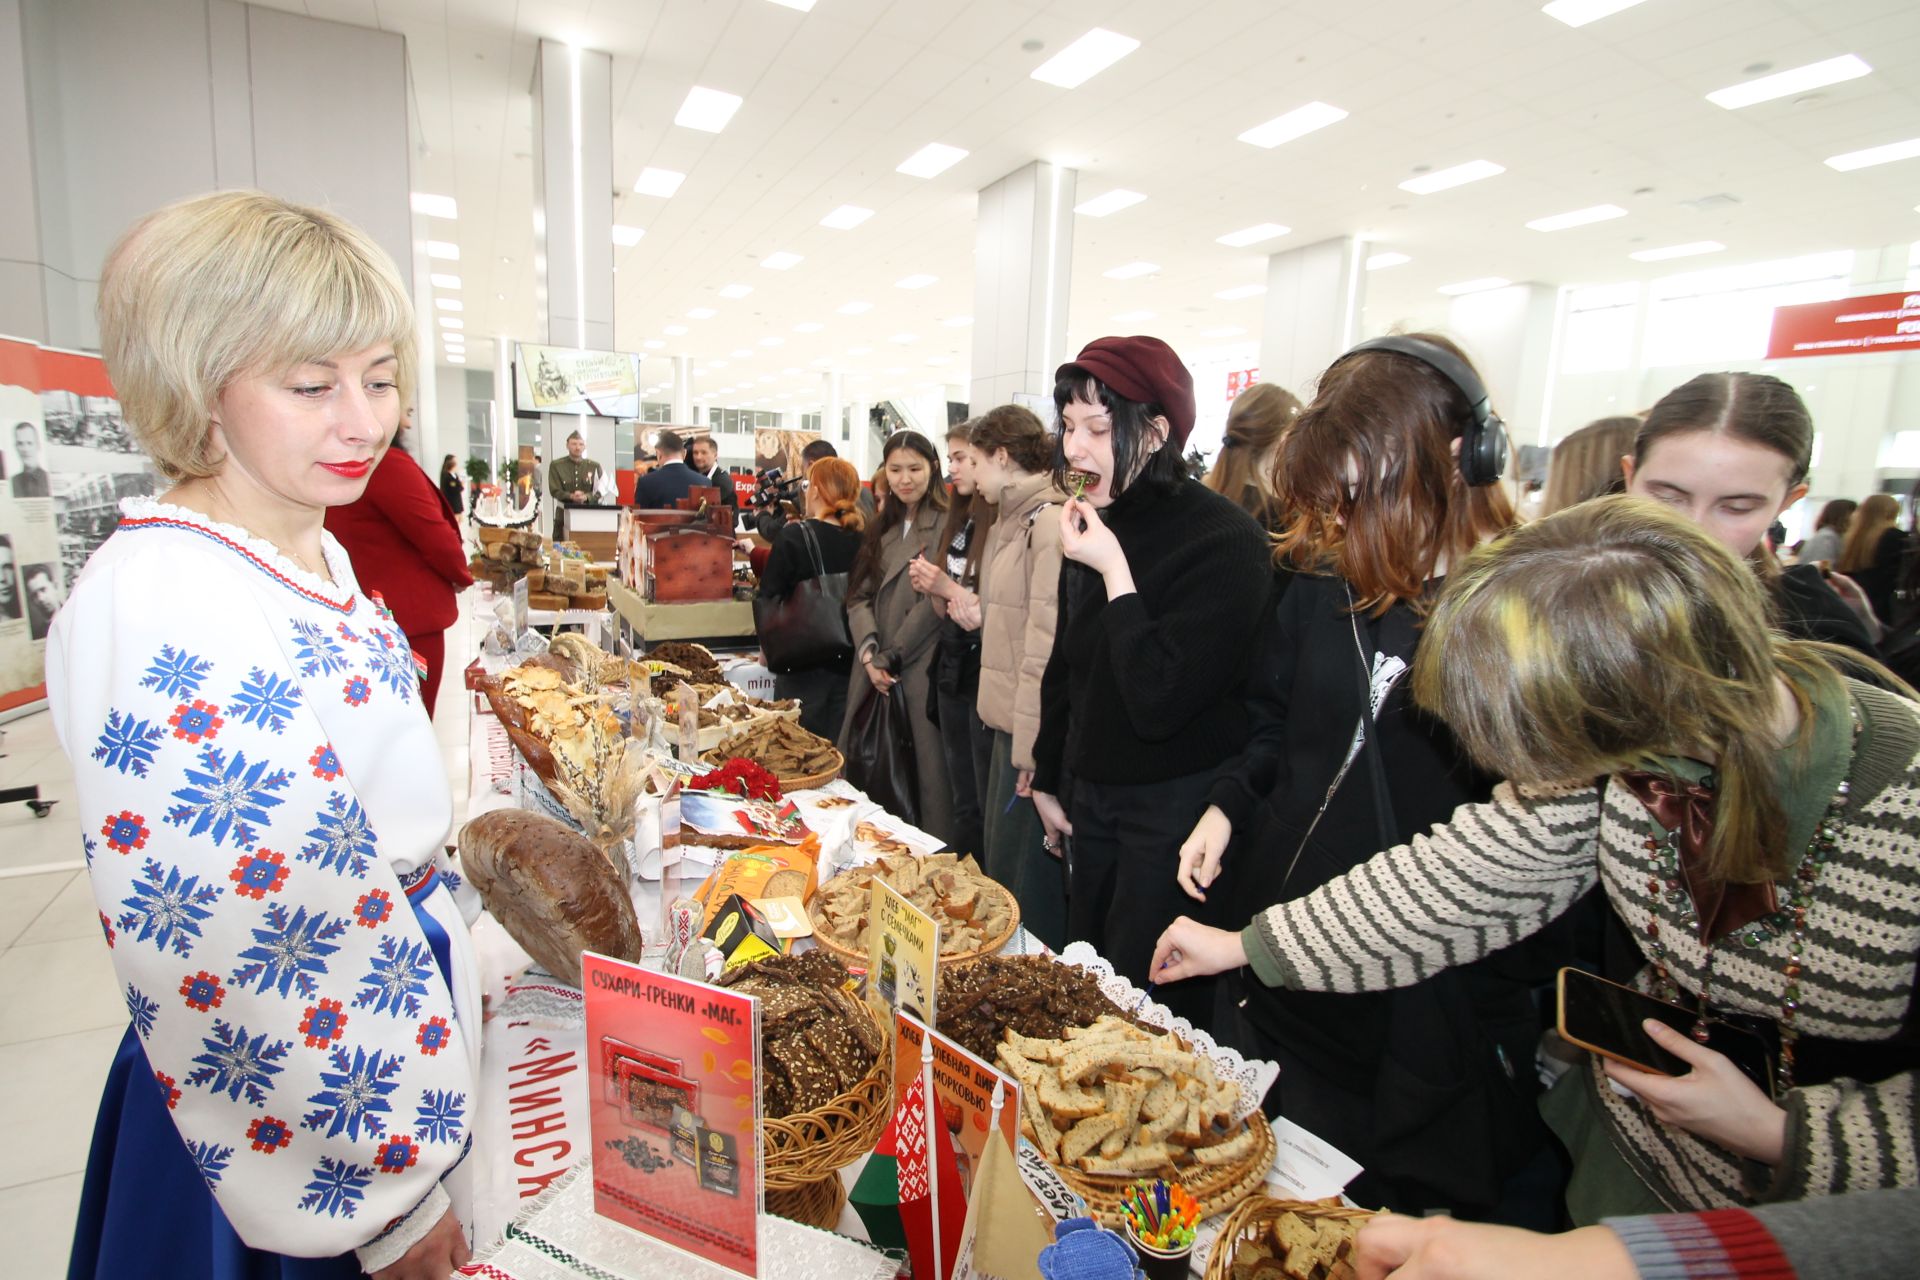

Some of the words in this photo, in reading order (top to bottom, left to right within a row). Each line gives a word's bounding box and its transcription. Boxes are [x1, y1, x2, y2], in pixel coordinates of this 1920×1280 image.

[885, 893, 899, 913] ХЛЕБ
[881, 908, 886, 921] С
[887, 914, 924, 953] СЕМЕЧКАМИ
[592, 969, 695, 1015] СУХАРИ-ГРЕНКИ
[901, 1026, 921, 1047] ХЛЕБ
[933, 1066, 985, 1112] МОРКОВЬЮ
